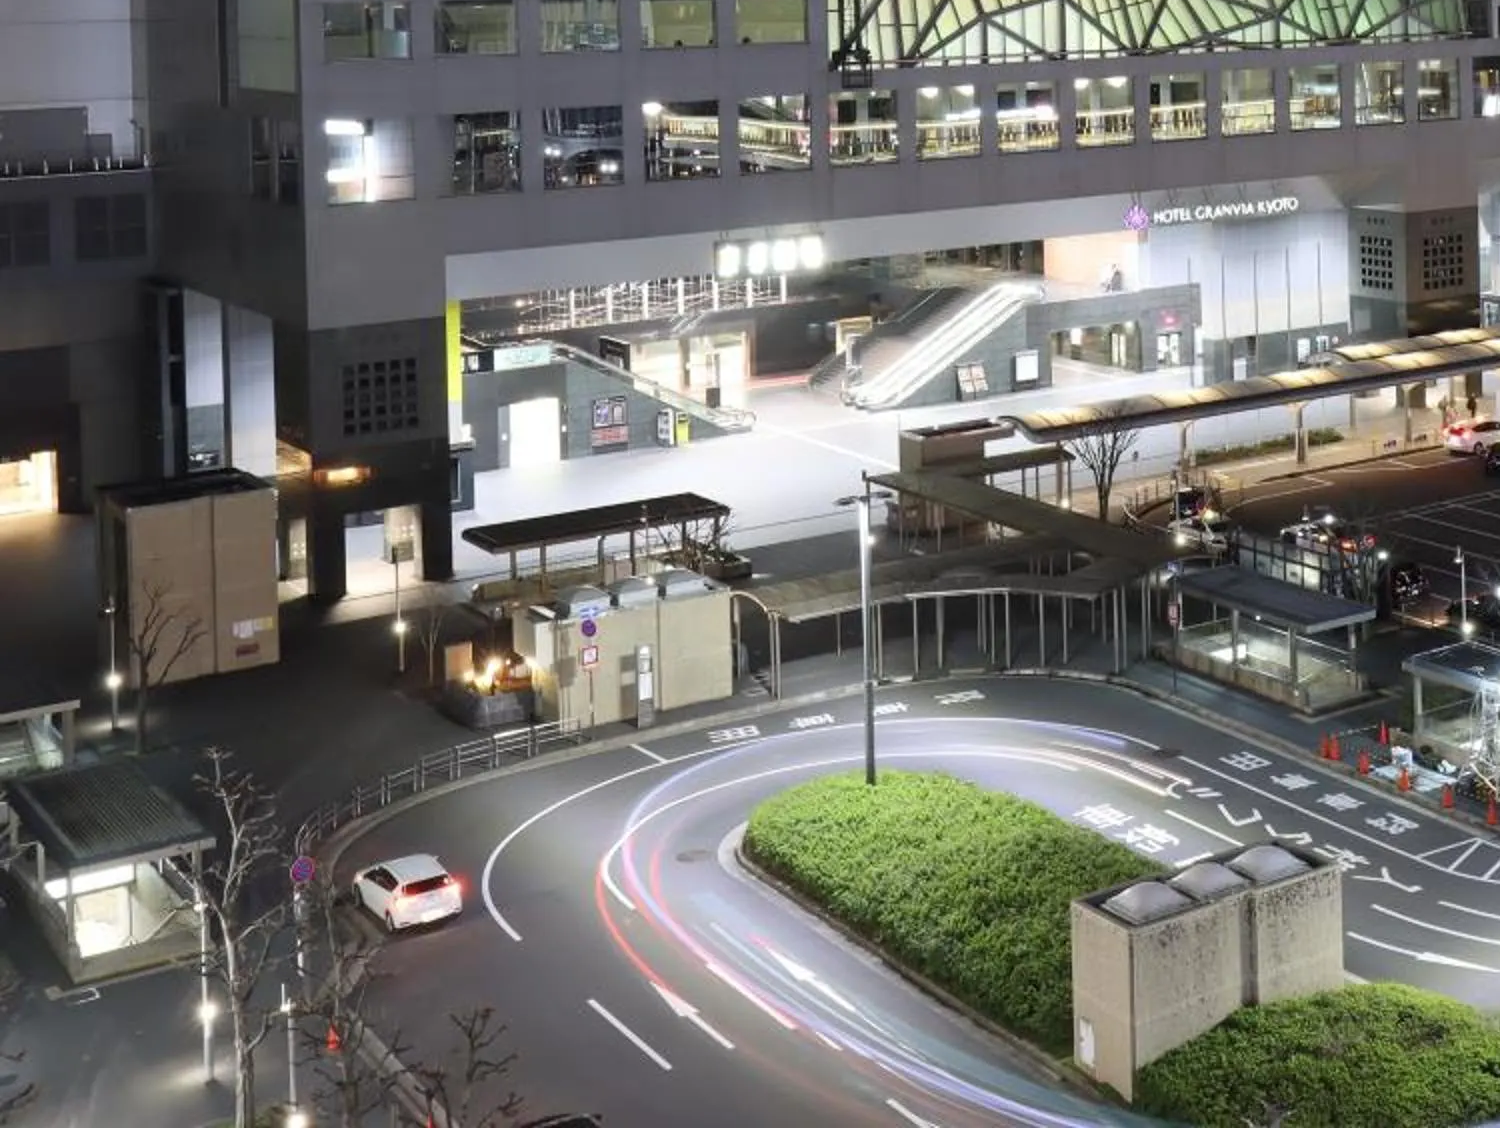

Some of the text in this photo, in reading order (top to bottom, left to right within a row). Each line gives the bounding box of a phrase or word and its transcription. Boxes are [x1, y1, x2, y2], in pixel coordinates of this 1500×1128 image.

[1153, 197, 1299, 224] HOTEL GRANVIA KYOTO
